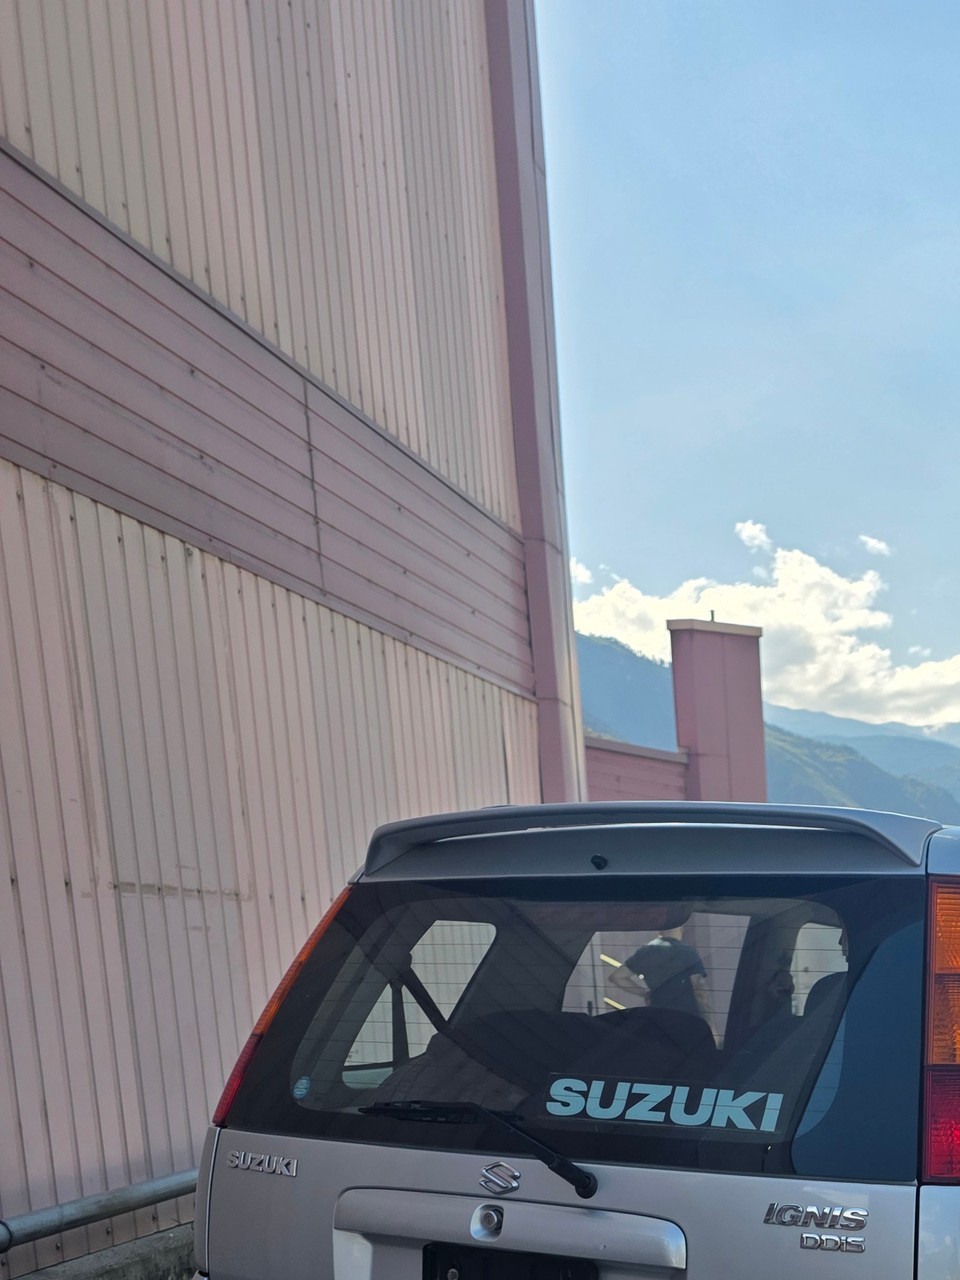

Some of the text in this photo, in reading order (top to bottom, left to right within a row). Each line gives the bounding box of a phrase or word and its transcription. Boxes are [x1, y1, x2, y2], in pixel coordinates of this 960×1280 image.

[546, 1078, 784, 1132] SUZUKI
[226, 1150, 298, 1177] SUZUKI
[763, 1202, 869, 1231] IGNIS
